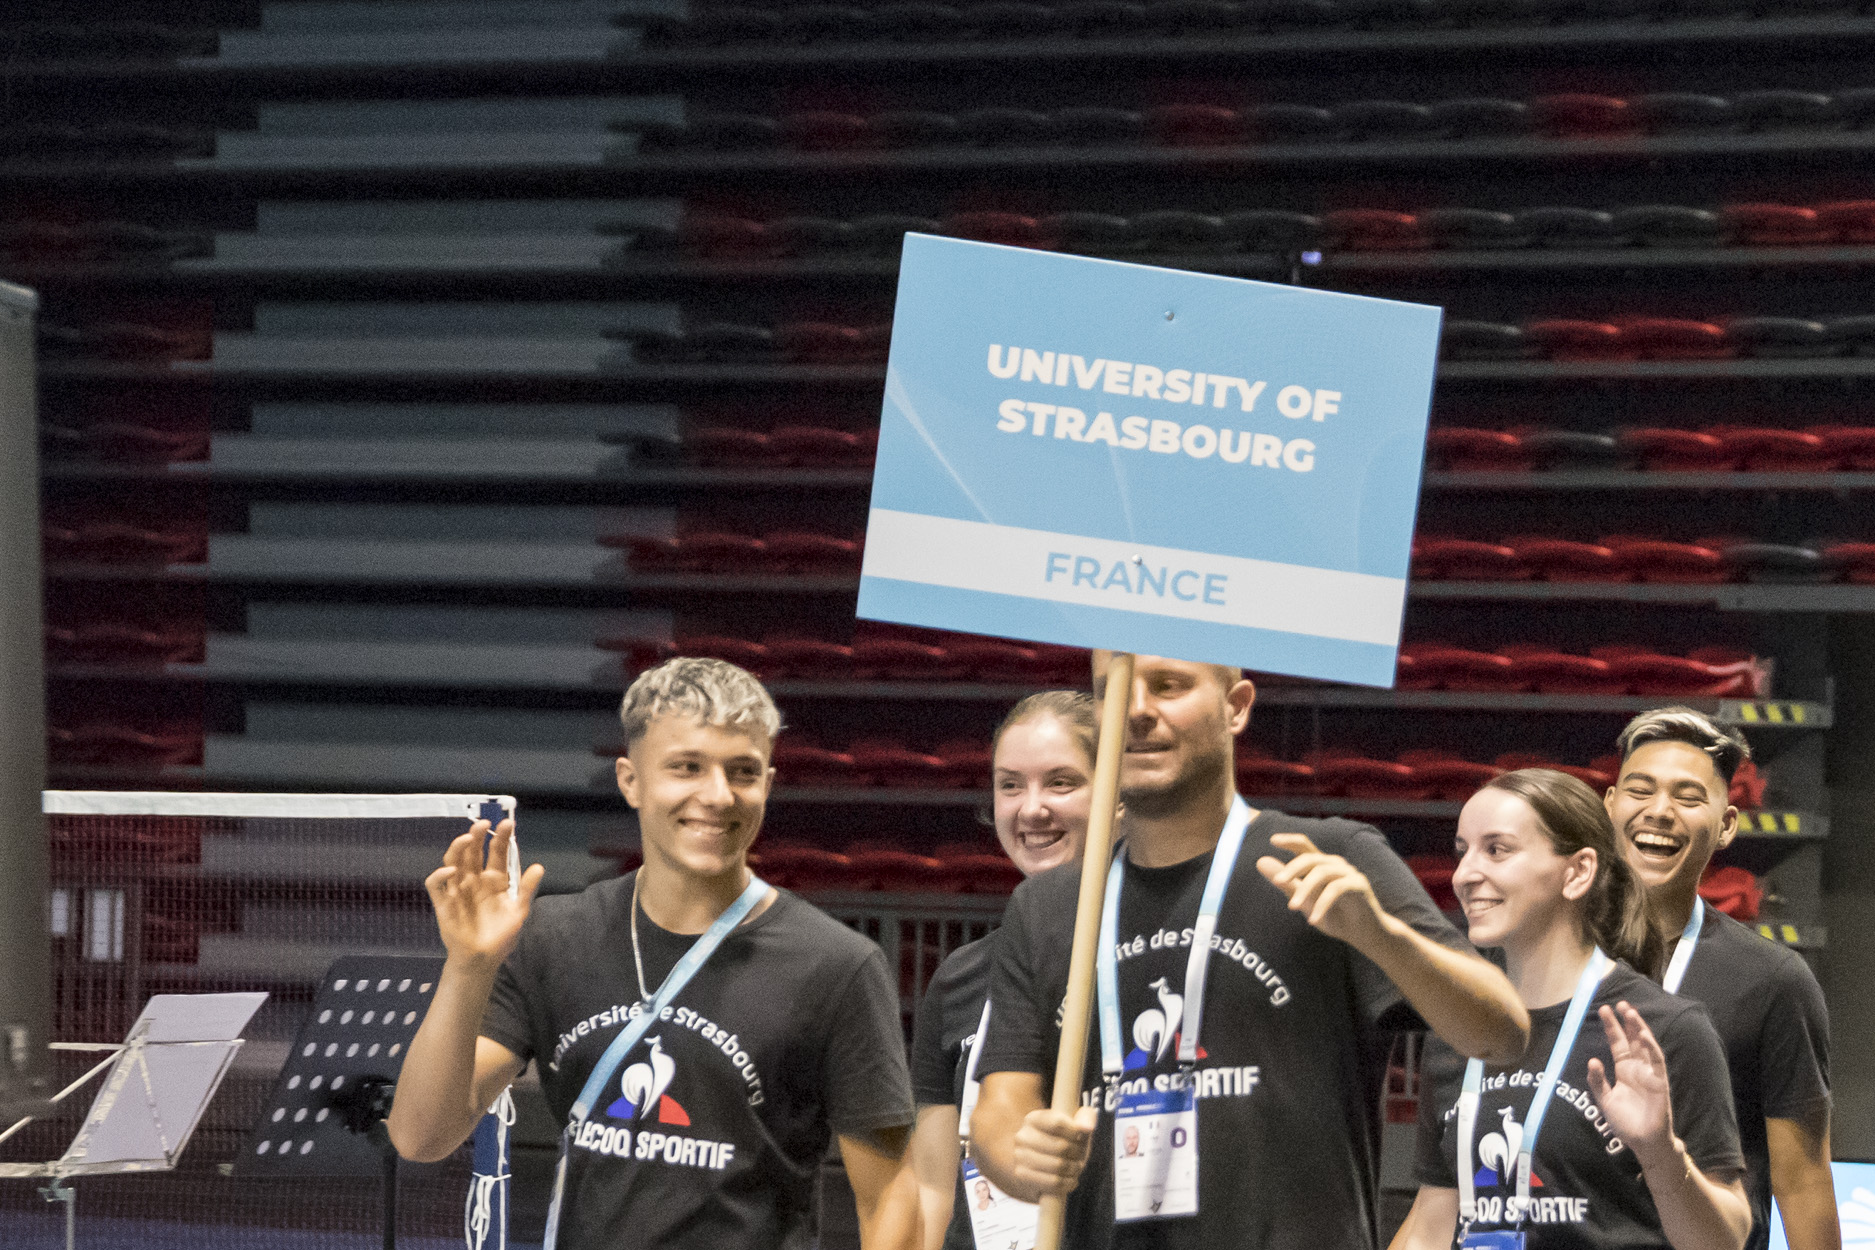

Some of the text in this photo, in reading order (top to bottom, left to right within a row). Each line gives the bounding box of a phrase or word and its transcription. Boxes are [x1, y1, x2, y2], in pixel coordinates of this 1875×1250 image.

[986, 342, 1342, 422] UNIVERSITY OF
[996, 398, 1316, 473] STRASBOURG
[1044, 551, 1229, 606] FRANCE
[1149, 928, 1178, 950] de
[1179, 927, 1292, 1008] Sasbourg
[1508, 1069, 1533, 1087] de
[634, 1130, 736, 1170] SPORTIF
[1504, 1196, 1589, 1224] SORTIF
